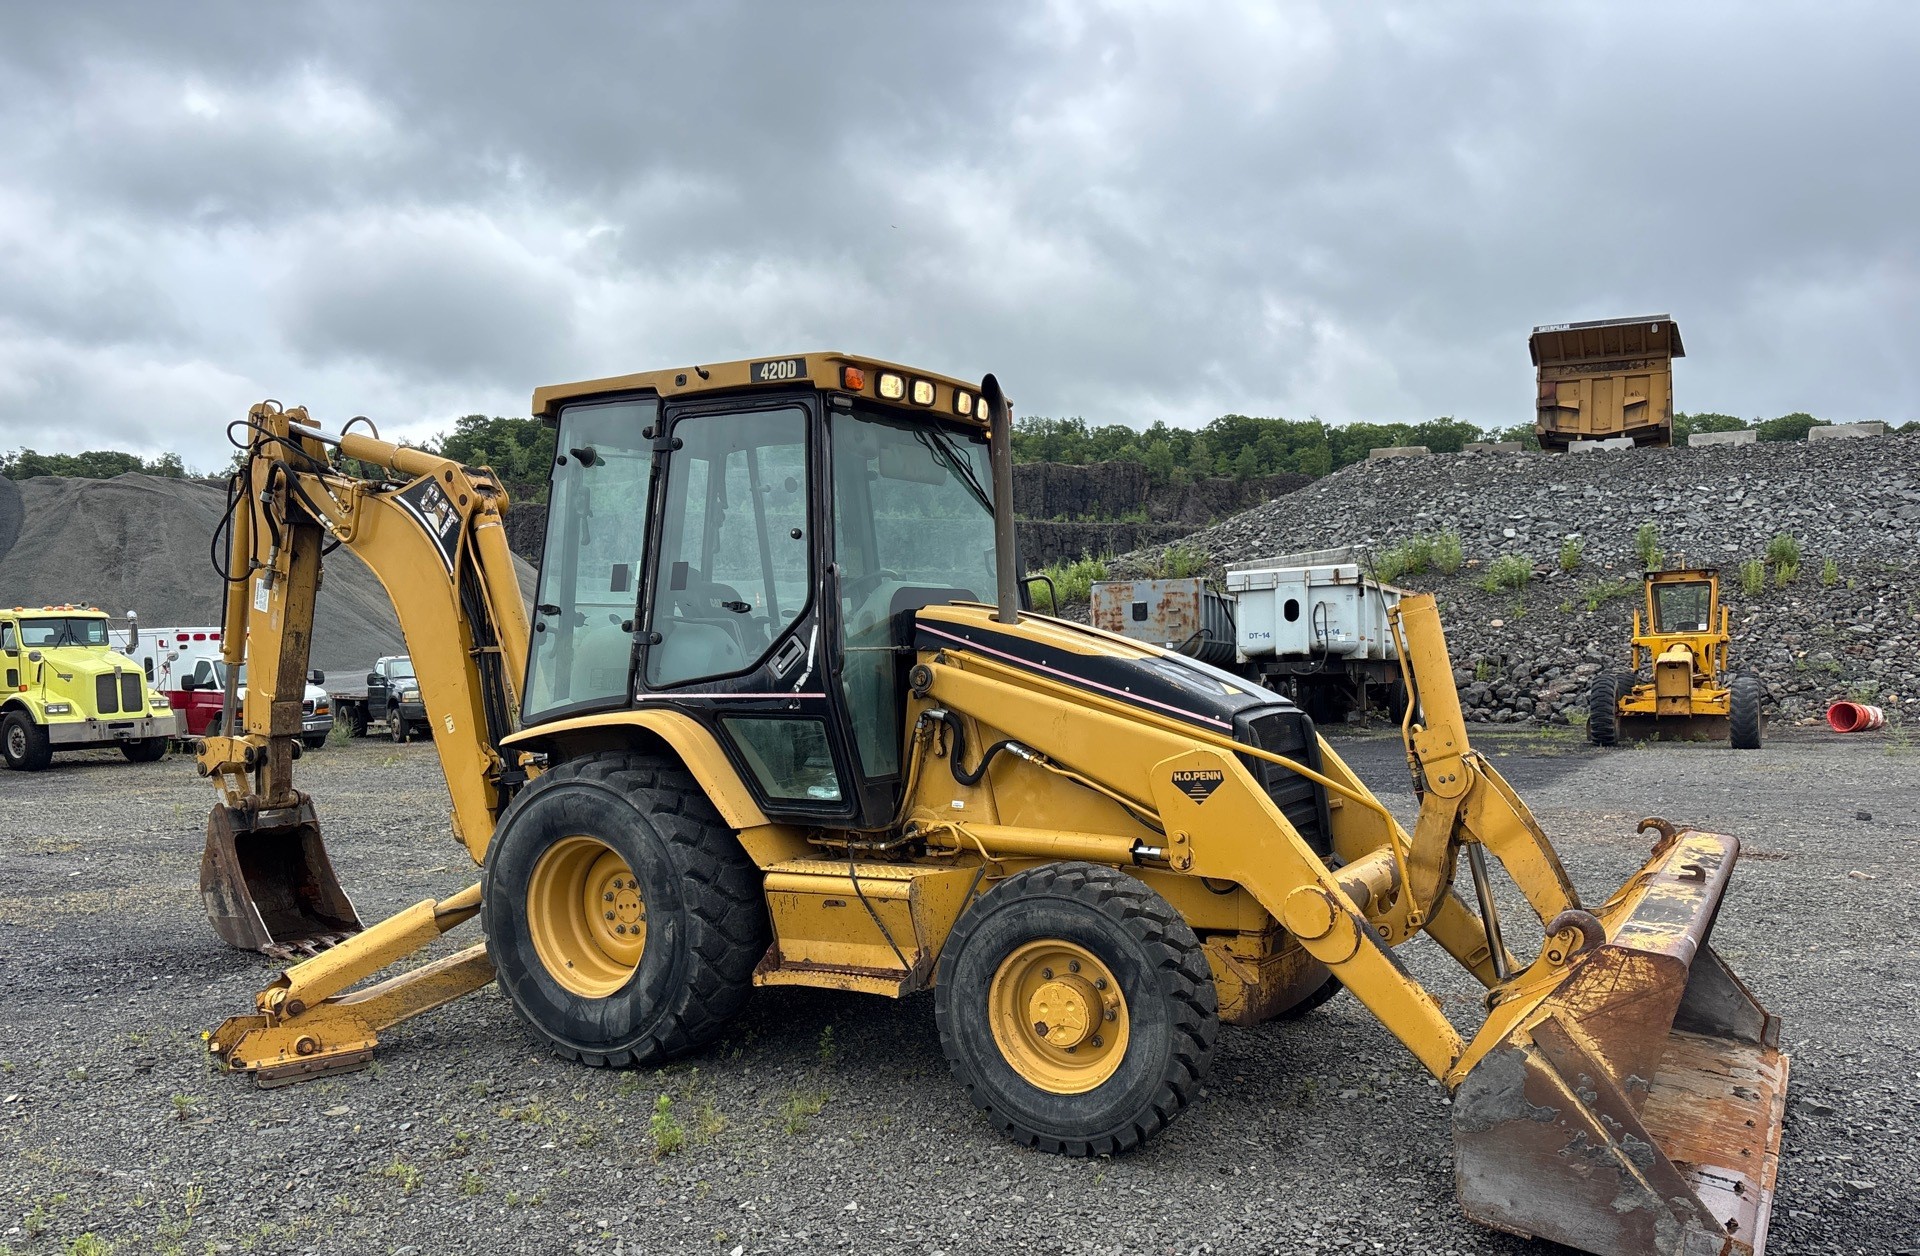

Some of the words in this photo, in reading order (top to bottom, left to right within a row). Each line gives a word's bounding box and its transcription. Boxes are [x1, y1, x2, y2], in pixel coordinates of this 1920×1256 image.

[760, 360, 797, 380] 420D
[1248, 632, 1271, 640] DT-14
[1173, 771, 1222, 782] H.O.PENN
